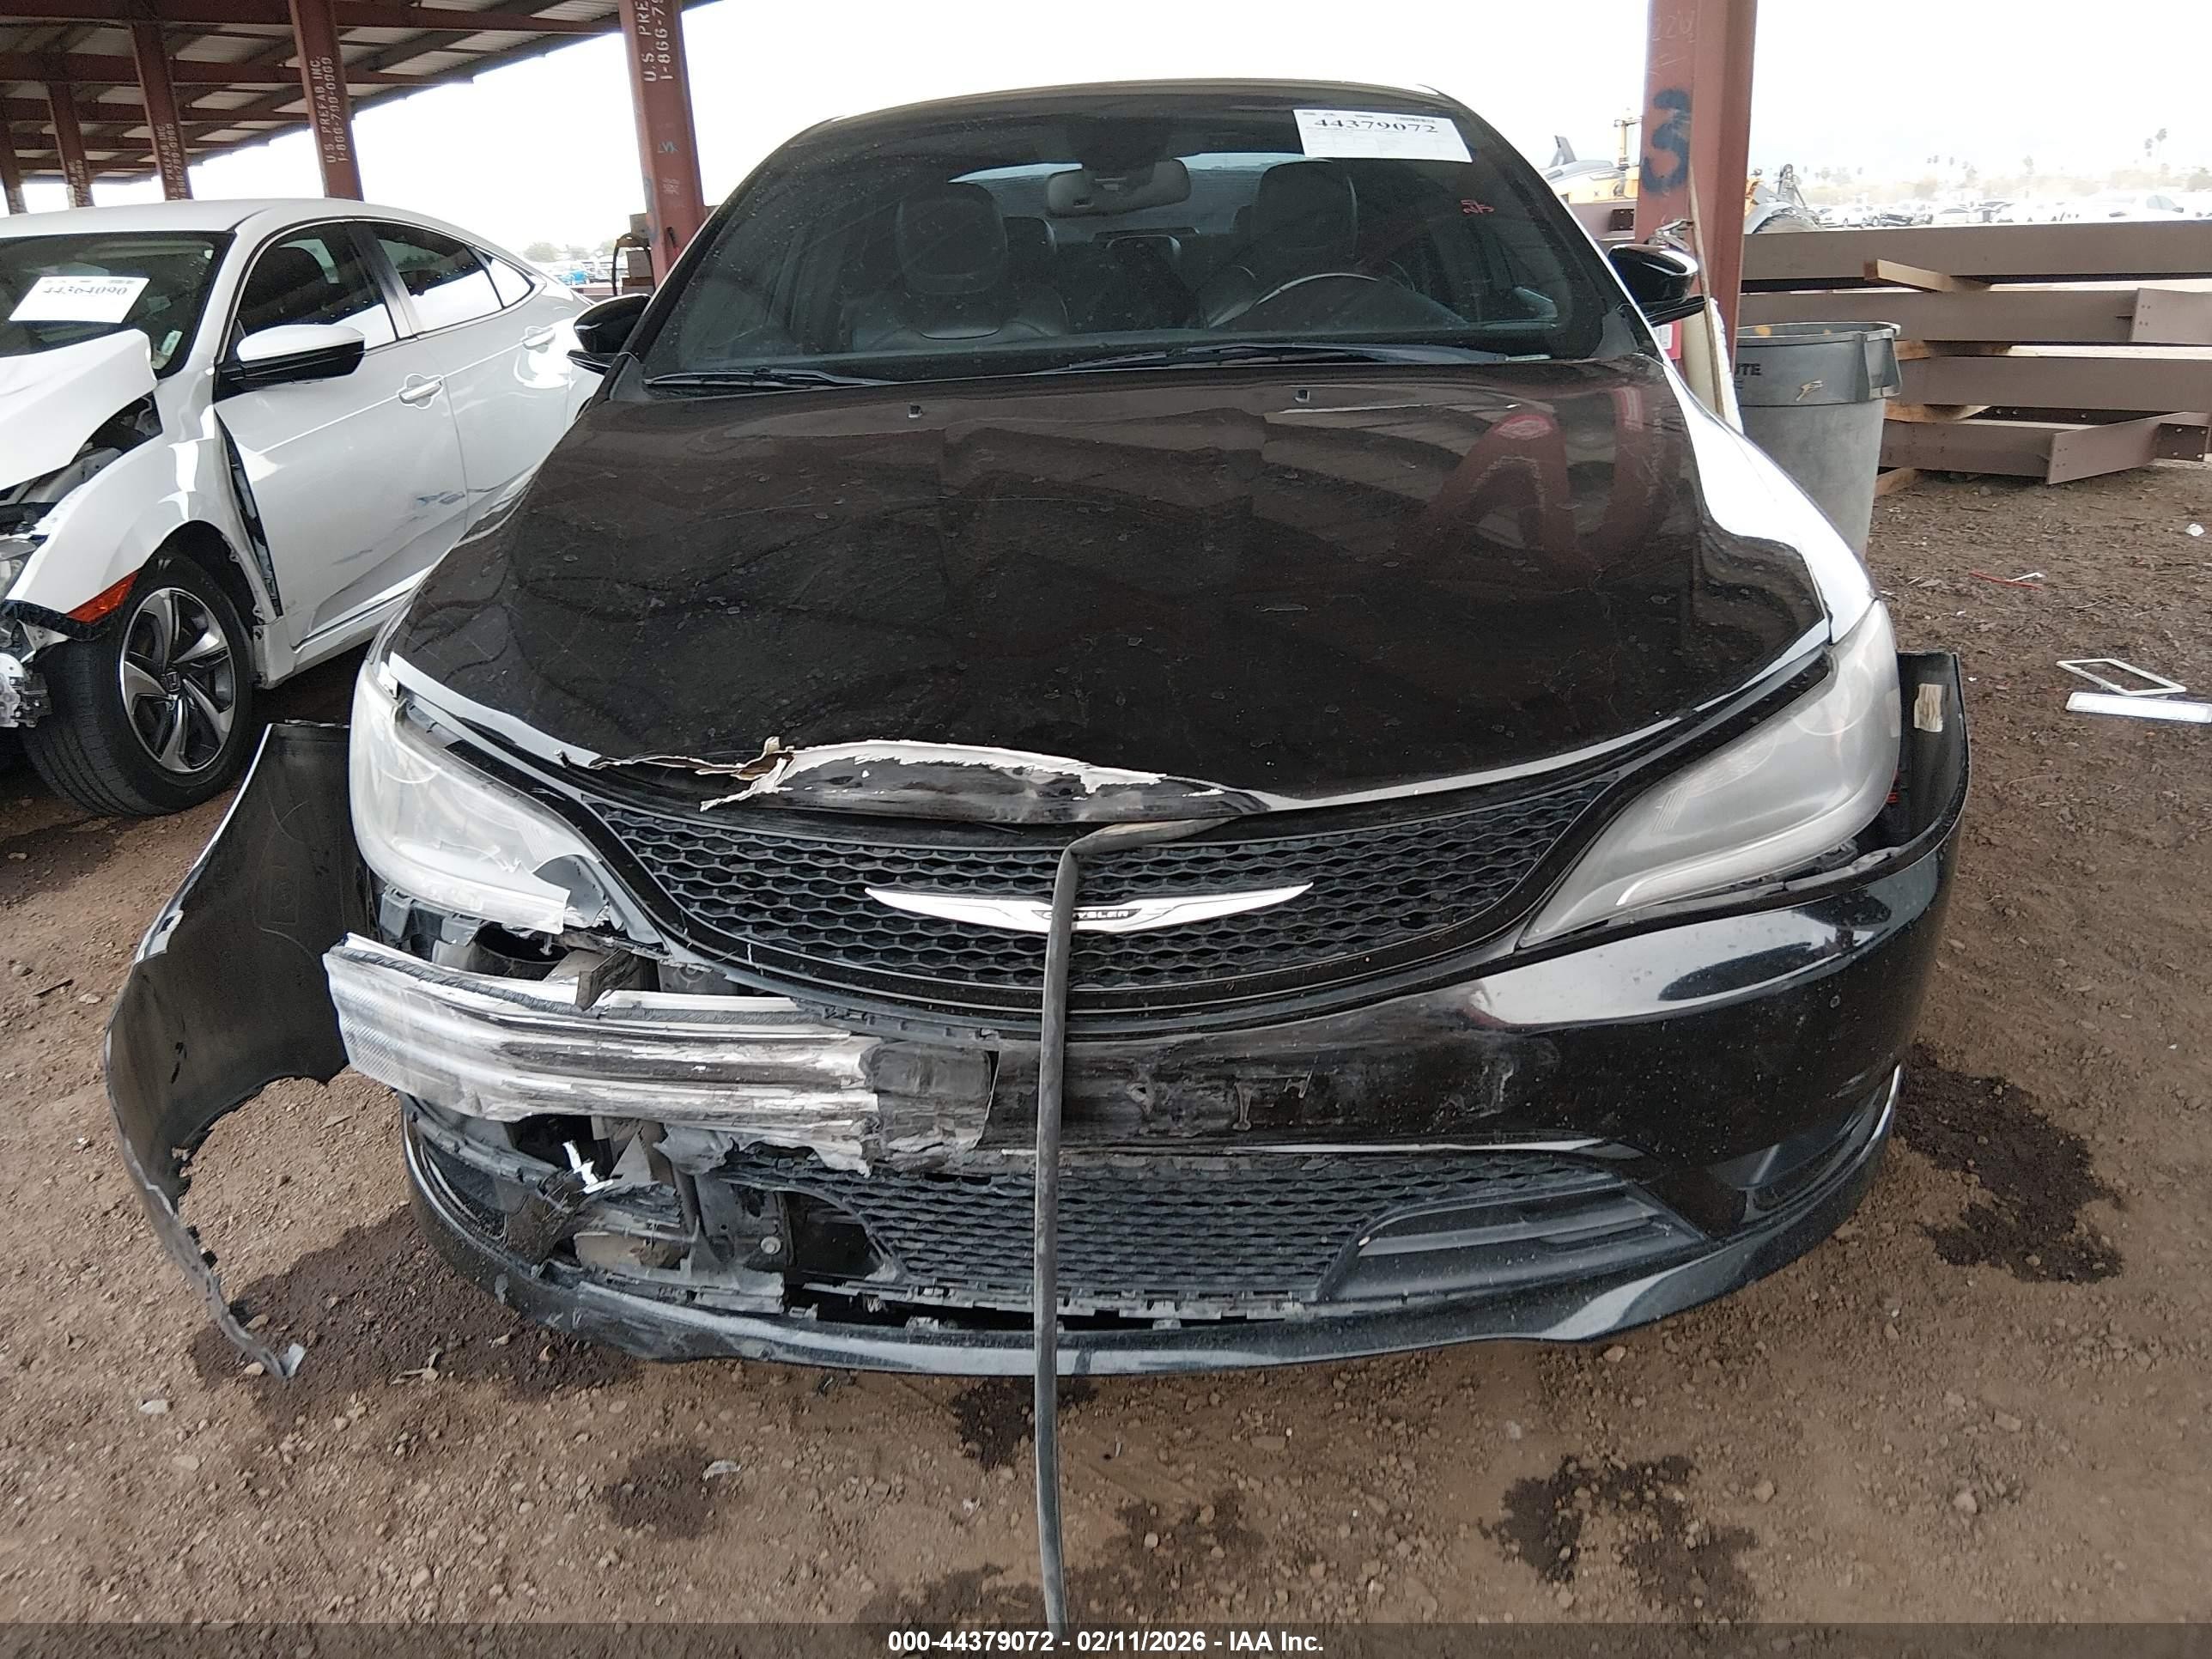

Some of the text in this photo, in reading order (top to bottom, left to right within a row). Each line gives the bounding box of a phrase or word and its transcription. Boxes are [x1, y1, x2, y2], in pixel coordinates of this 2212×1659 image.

[314, 87, 331, 134] PREFAB
[1315, 118, 1438, 133] 44379072
[1642, 88, 1692, 193] 3
[1042, 910, 1129, 919] CYSLER
